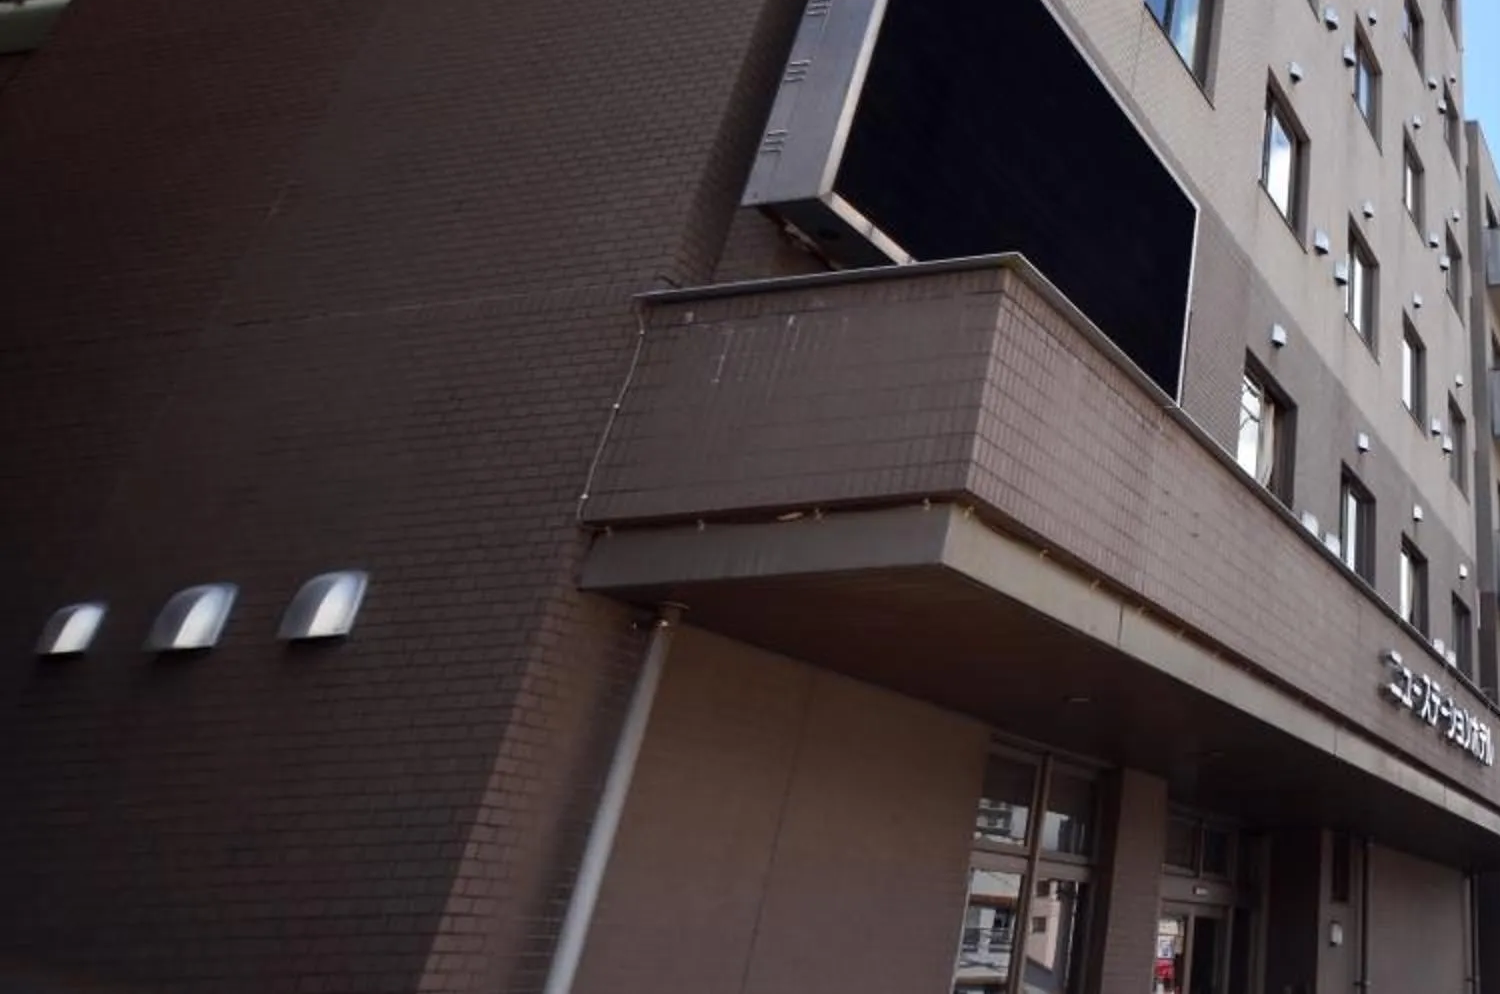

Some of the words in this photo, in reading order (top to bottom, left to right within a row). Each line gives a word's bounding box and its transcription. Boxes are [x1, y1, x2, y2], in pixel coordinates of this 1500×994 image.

[1389, 649, 1493, 767] ニューステーションホテル
